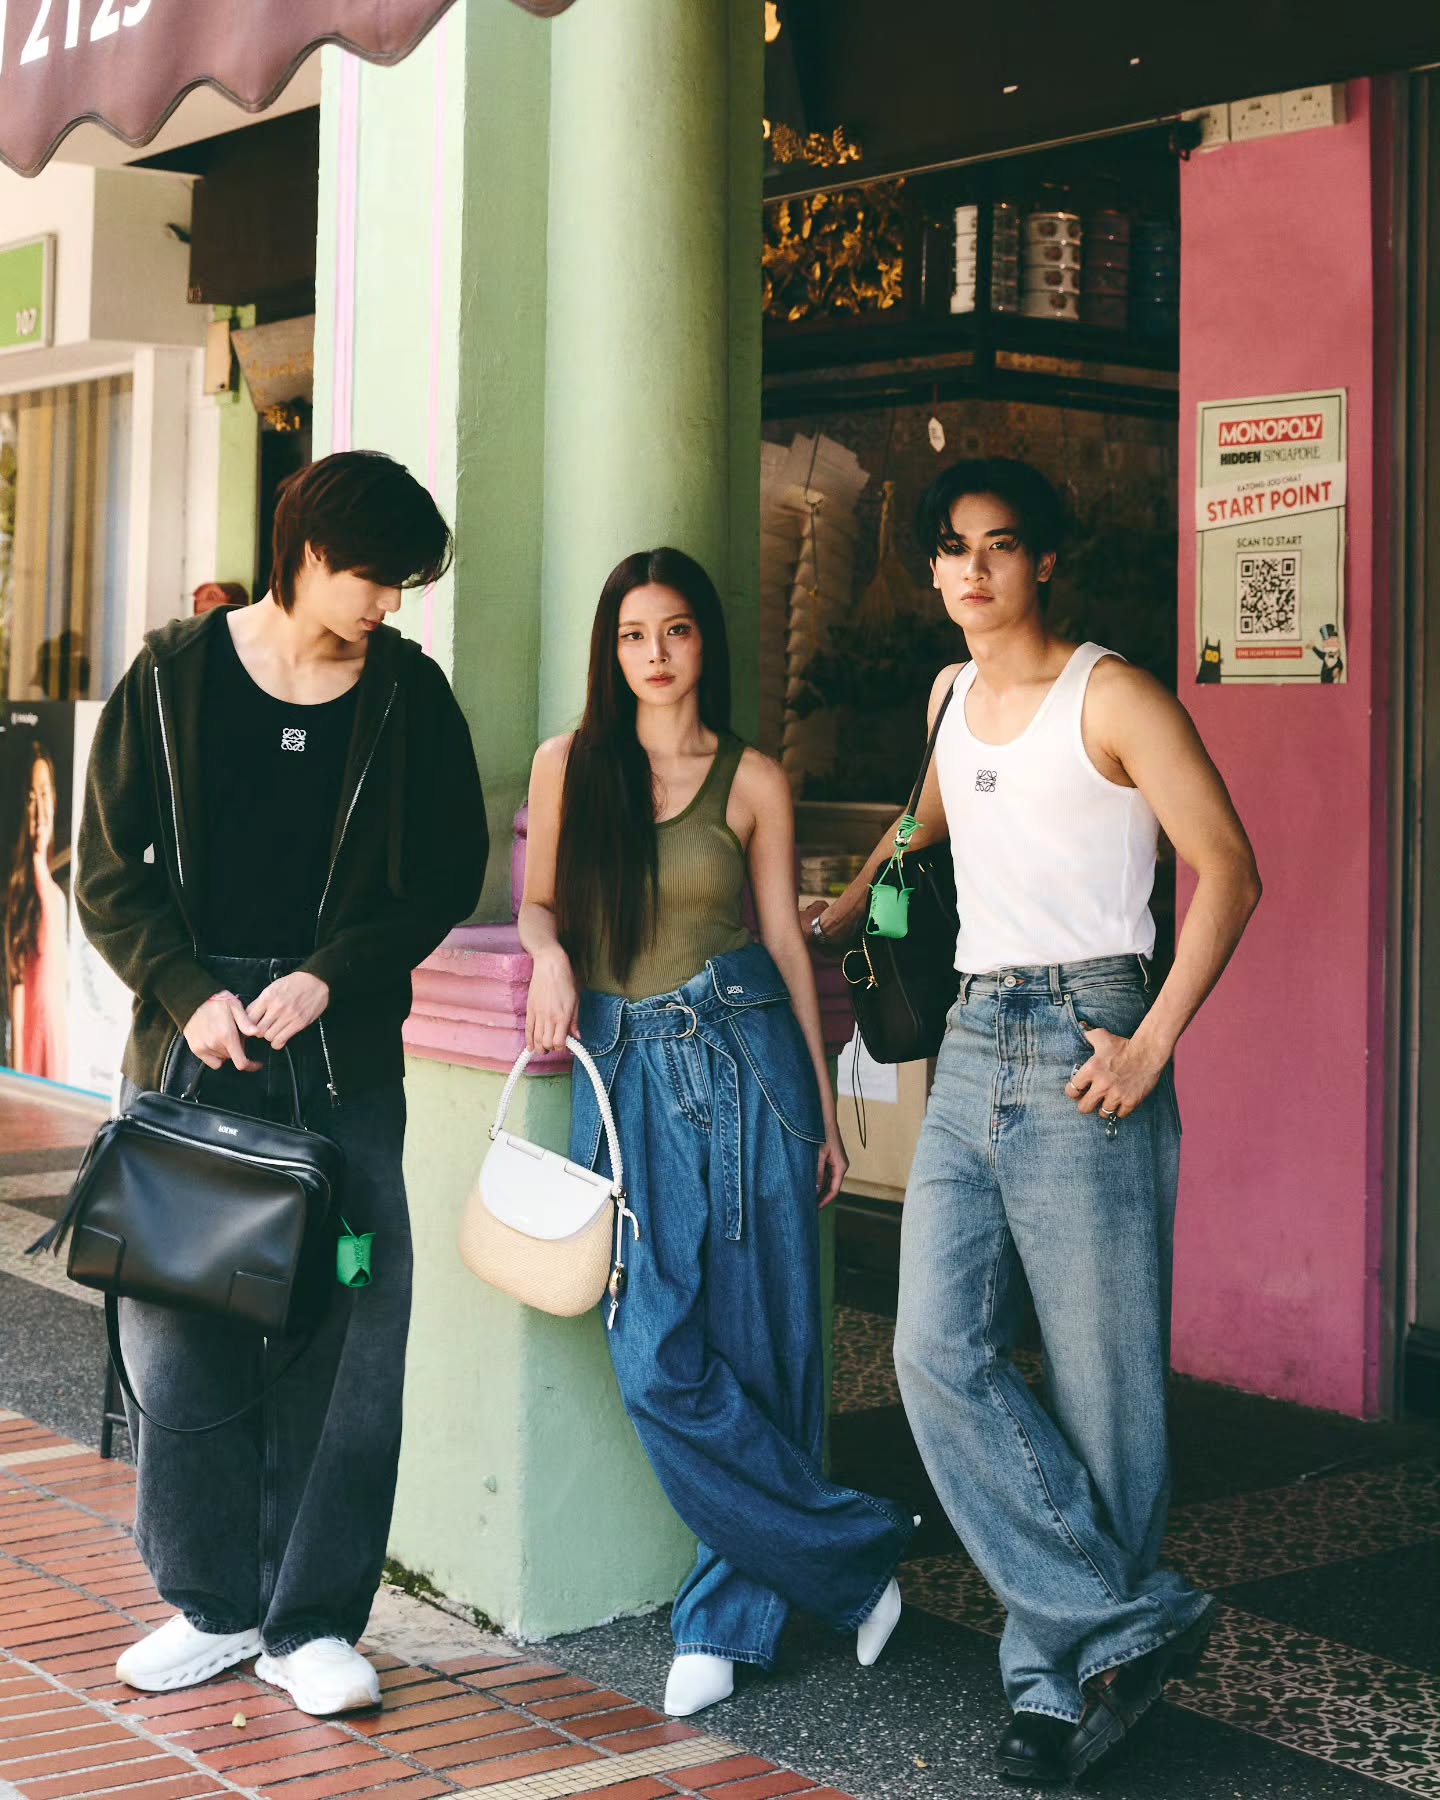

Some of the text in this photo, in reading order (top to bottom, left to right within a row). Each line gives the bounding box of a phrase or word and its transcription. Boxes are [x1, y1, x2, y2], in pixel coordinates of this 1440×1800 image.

[1220, 416, 1322, 445] MONOPOLY
[1220, 446, 1320, 465] HIDDEN SINGAPORE
[1207, 480, 1333, 522] START POINT
[1236, 535, 1302, 548] SCAN TO START
